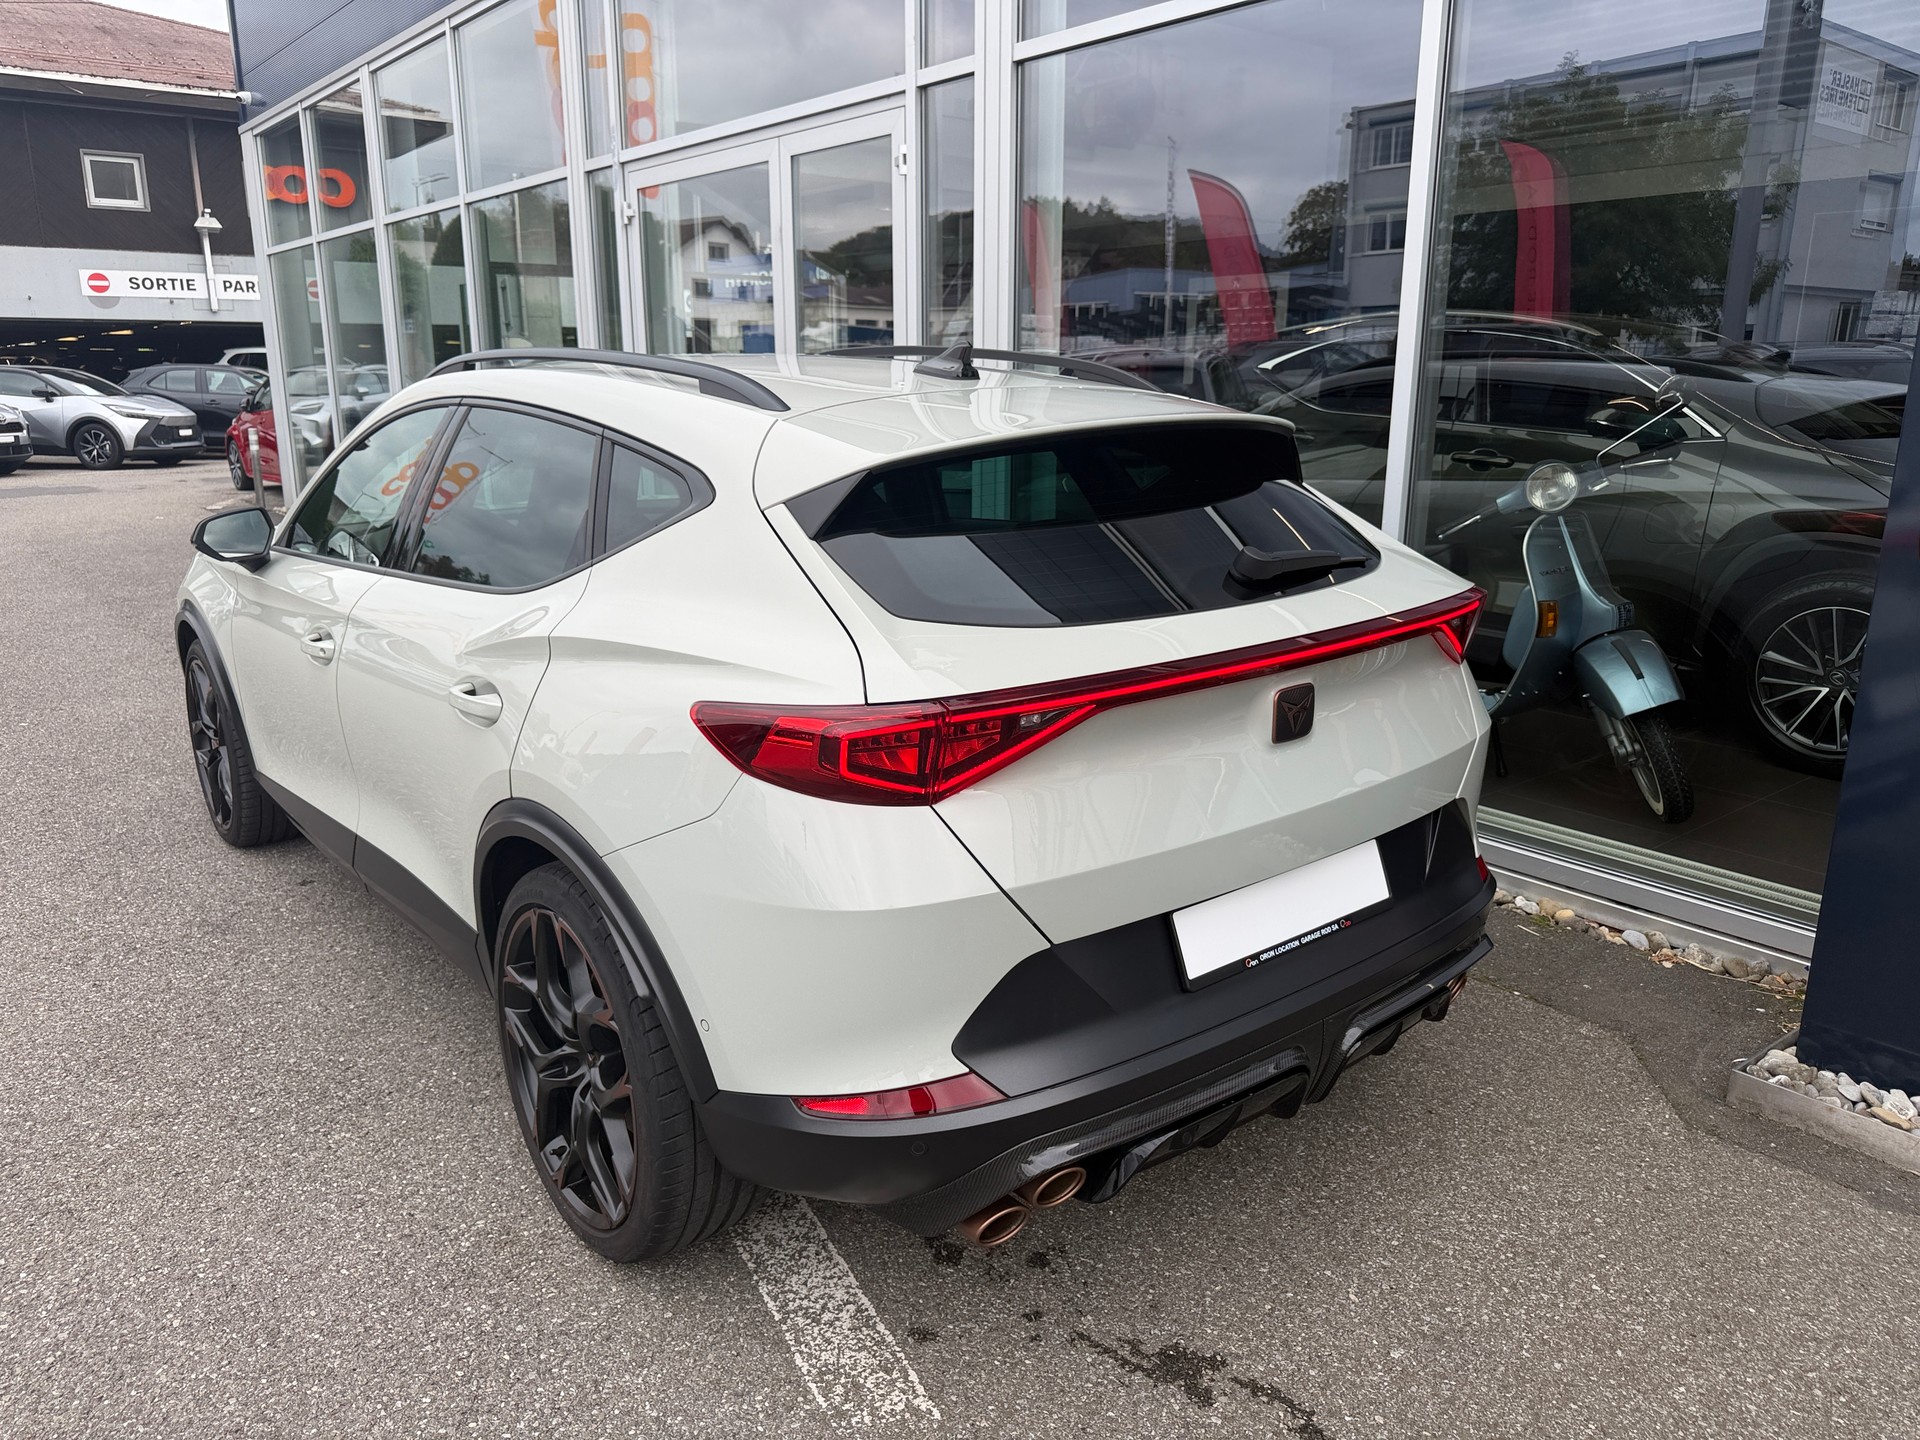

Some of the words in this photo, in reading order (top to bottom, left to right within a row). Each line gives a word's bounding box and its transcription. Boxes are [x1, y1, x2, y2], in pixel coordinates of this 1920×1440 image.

[129, 276, 197, 292] SORTIE
[222, 279, 259, 293] PAR
[1259, 951, 1276, 962] ORON
[1275, 940, 1300, 955] LOCATION
[1300, 931, 1321, 943] GARAGE
[1320, 926, 1332, 936] ROD
[1331, 923, 1339, 931] SA
